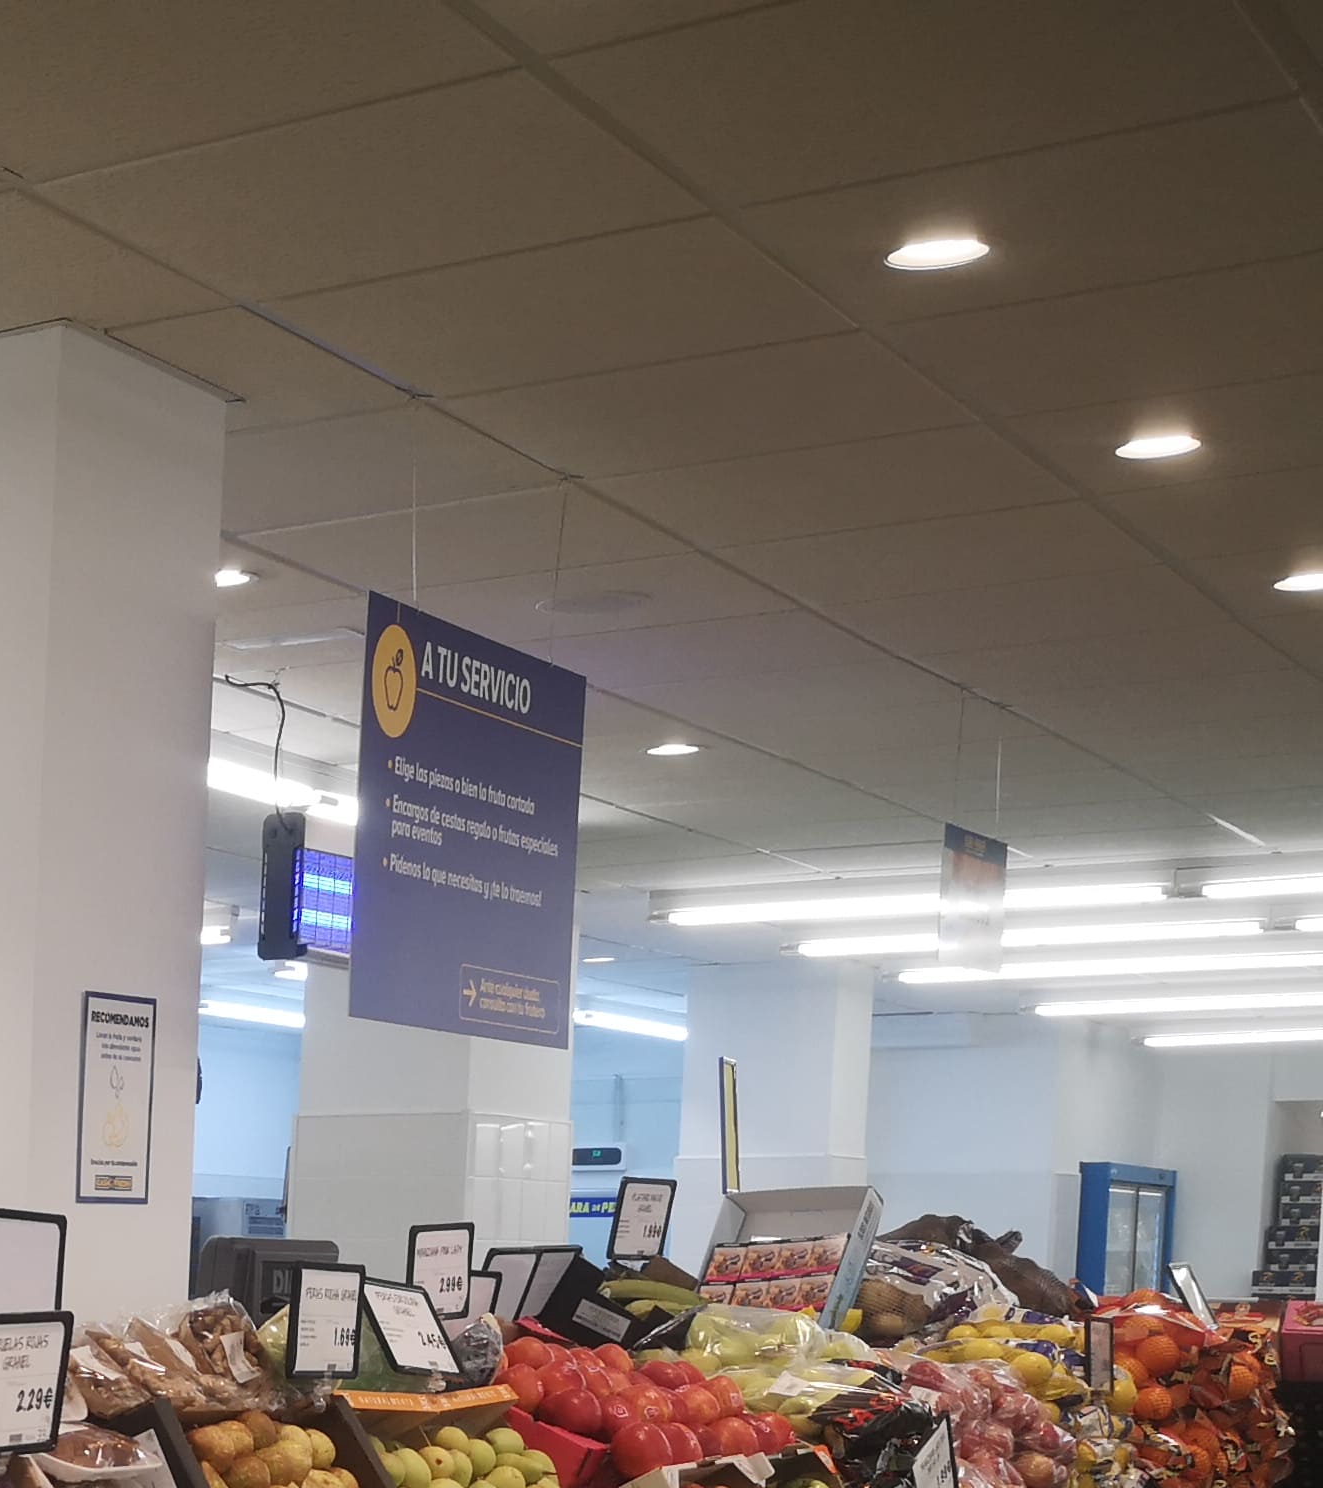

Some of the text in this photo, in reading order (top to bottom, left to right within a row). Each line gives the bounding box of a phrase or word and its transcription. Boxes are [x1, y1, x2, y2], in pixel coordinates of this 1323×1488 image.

[421, 641, 532, 714] A TU SERVICIO
[395, 756, 414, 782] Elige
[91, 1010, 150, 1028] RECOMENDAMOS
[15, 1386, 54, 1412] 2.29€
